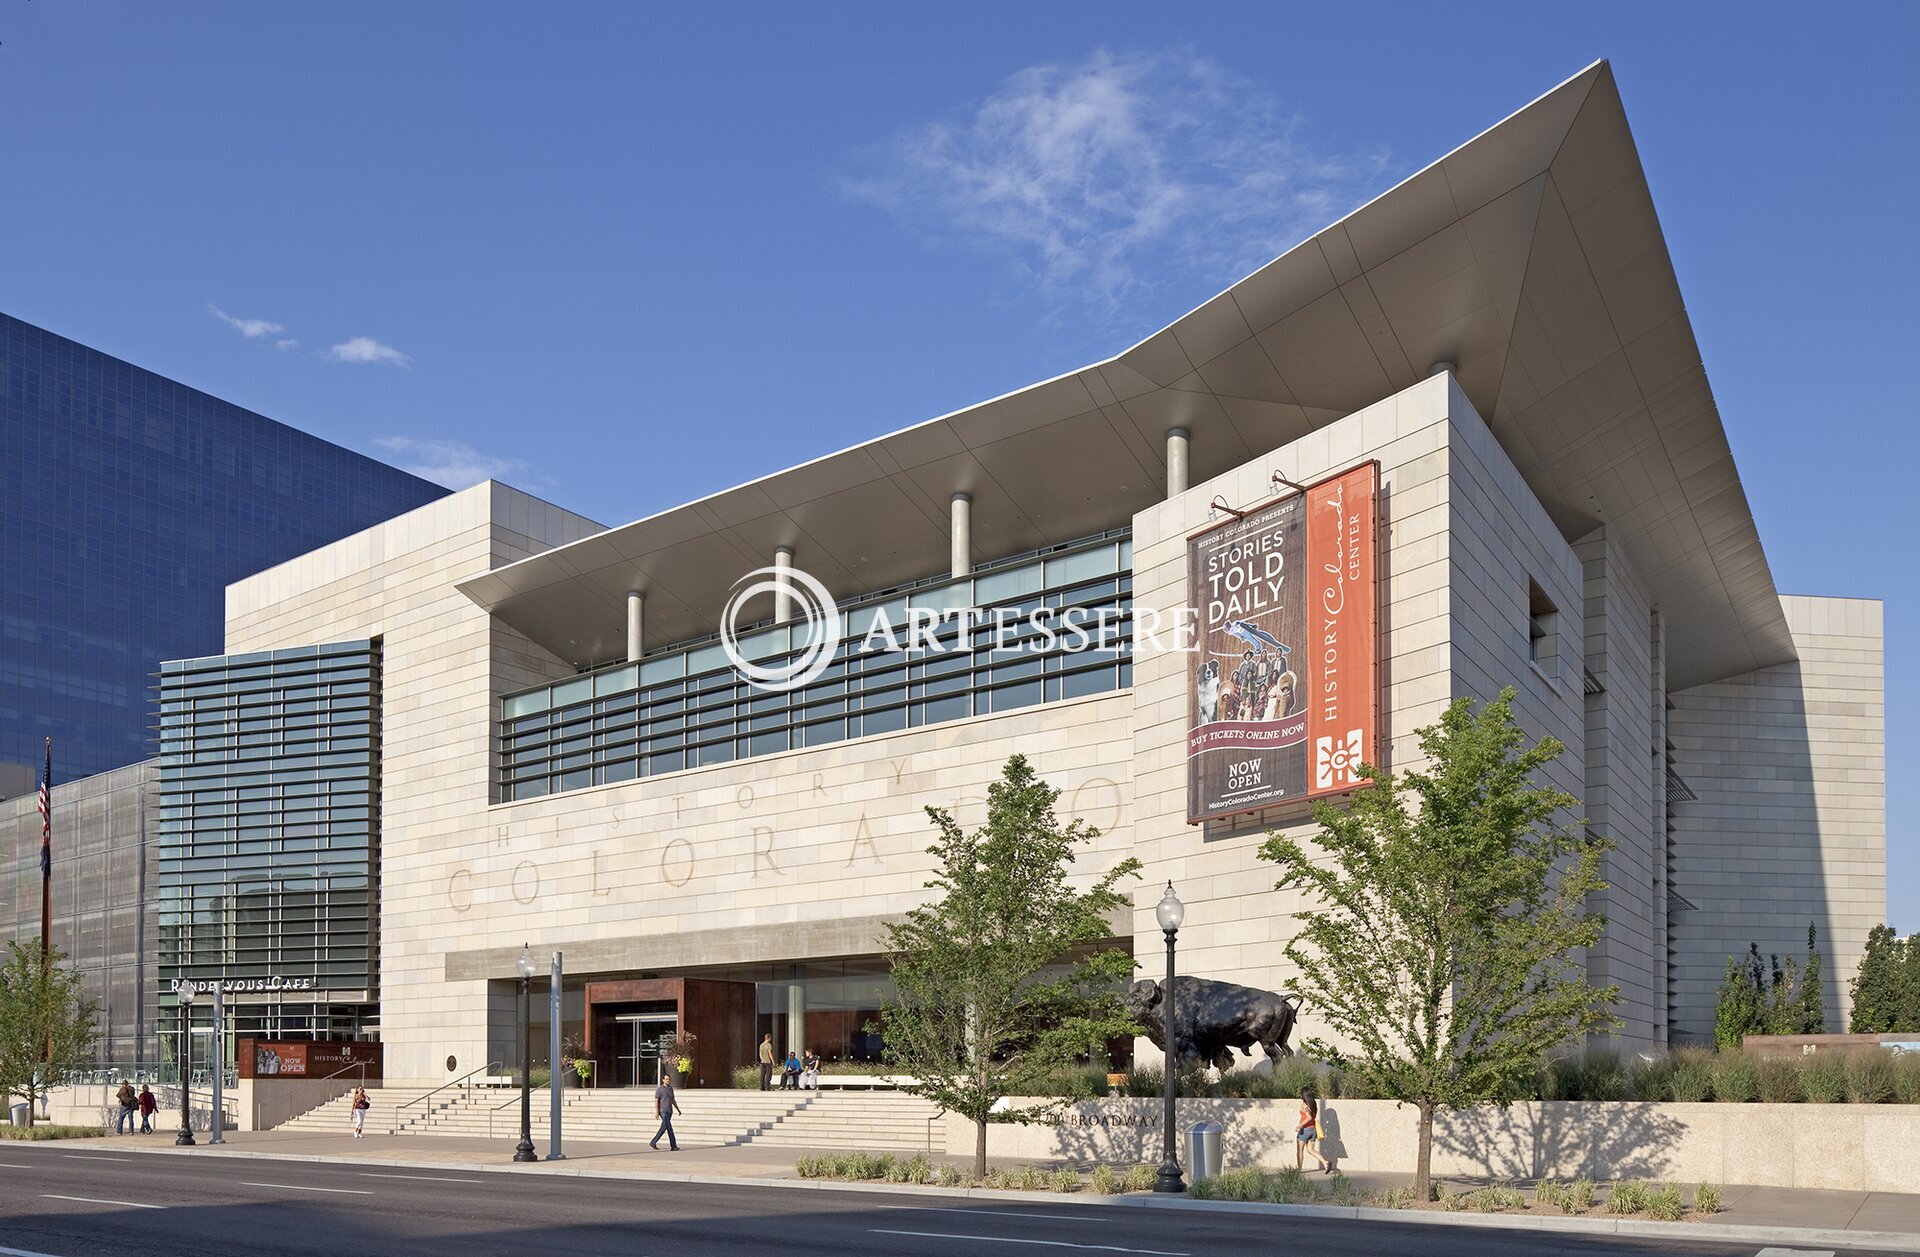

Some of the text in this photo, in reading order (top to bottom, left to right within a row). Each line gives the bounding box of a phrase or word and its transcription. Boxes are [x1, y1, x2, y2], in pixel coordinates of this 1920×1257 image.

[1198, 504, 1295, 549] HISTORY COLORADO PRESENTS
[1349, 513, 1361, 581] CENTER
[1208, 530, 1284, 573] STORIES
[1208, 552, 1284, 598] TOLD
[1208, 576, 1285, 625] DAILY
[1323, 478, 1344, 722] HISTORY Colorado
[1190, 722, 1305, 747] BUY TICKETS ONLINE NOW
[1228, 757, 1263, 778] NOW
[1228, 772, 1262, 790] OPEN
[497, 759, 907, 847] HISTORY
[1208, 788, 1285, 810] HistoryColoradoCenter.org
[448, 778, 1122, 913] COLORAO
[171, 978, 264, 993] RNDEVOUS
[280, 1064, 306, 1072] OPEN
[1071, 1114, 1158, 1127] BROADWAY
